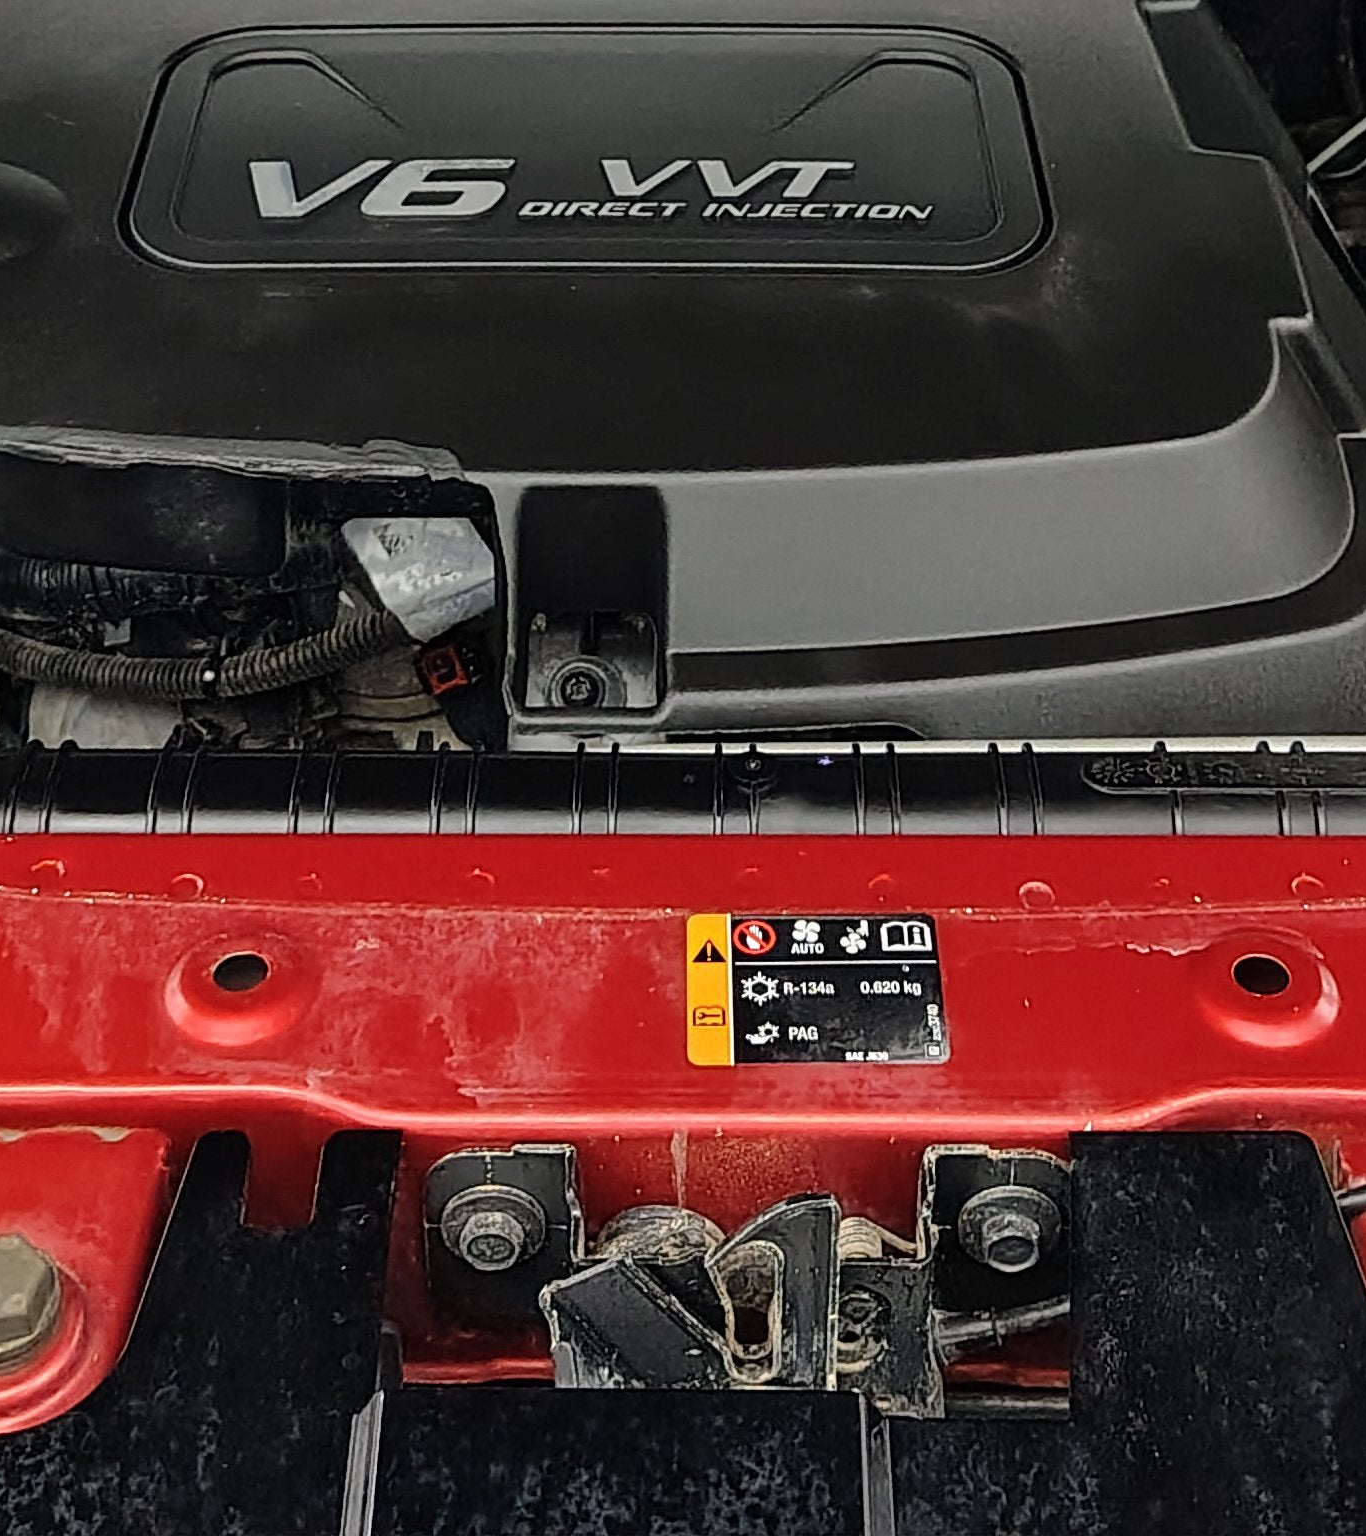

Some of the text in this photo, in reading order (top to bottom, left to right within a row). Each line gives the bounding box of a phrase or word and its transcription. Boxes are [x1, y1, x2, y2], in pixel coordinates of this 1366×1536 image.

[249, 159, 856, 217] V6 VVT
[518, 202, 934, 220] DIRECT INJECTION
[791, 942, 825, 955] AUTO
[783, 980, 922, 997] R-134a 0.620 kg
[788, 1026, 819, 1041] PAG
